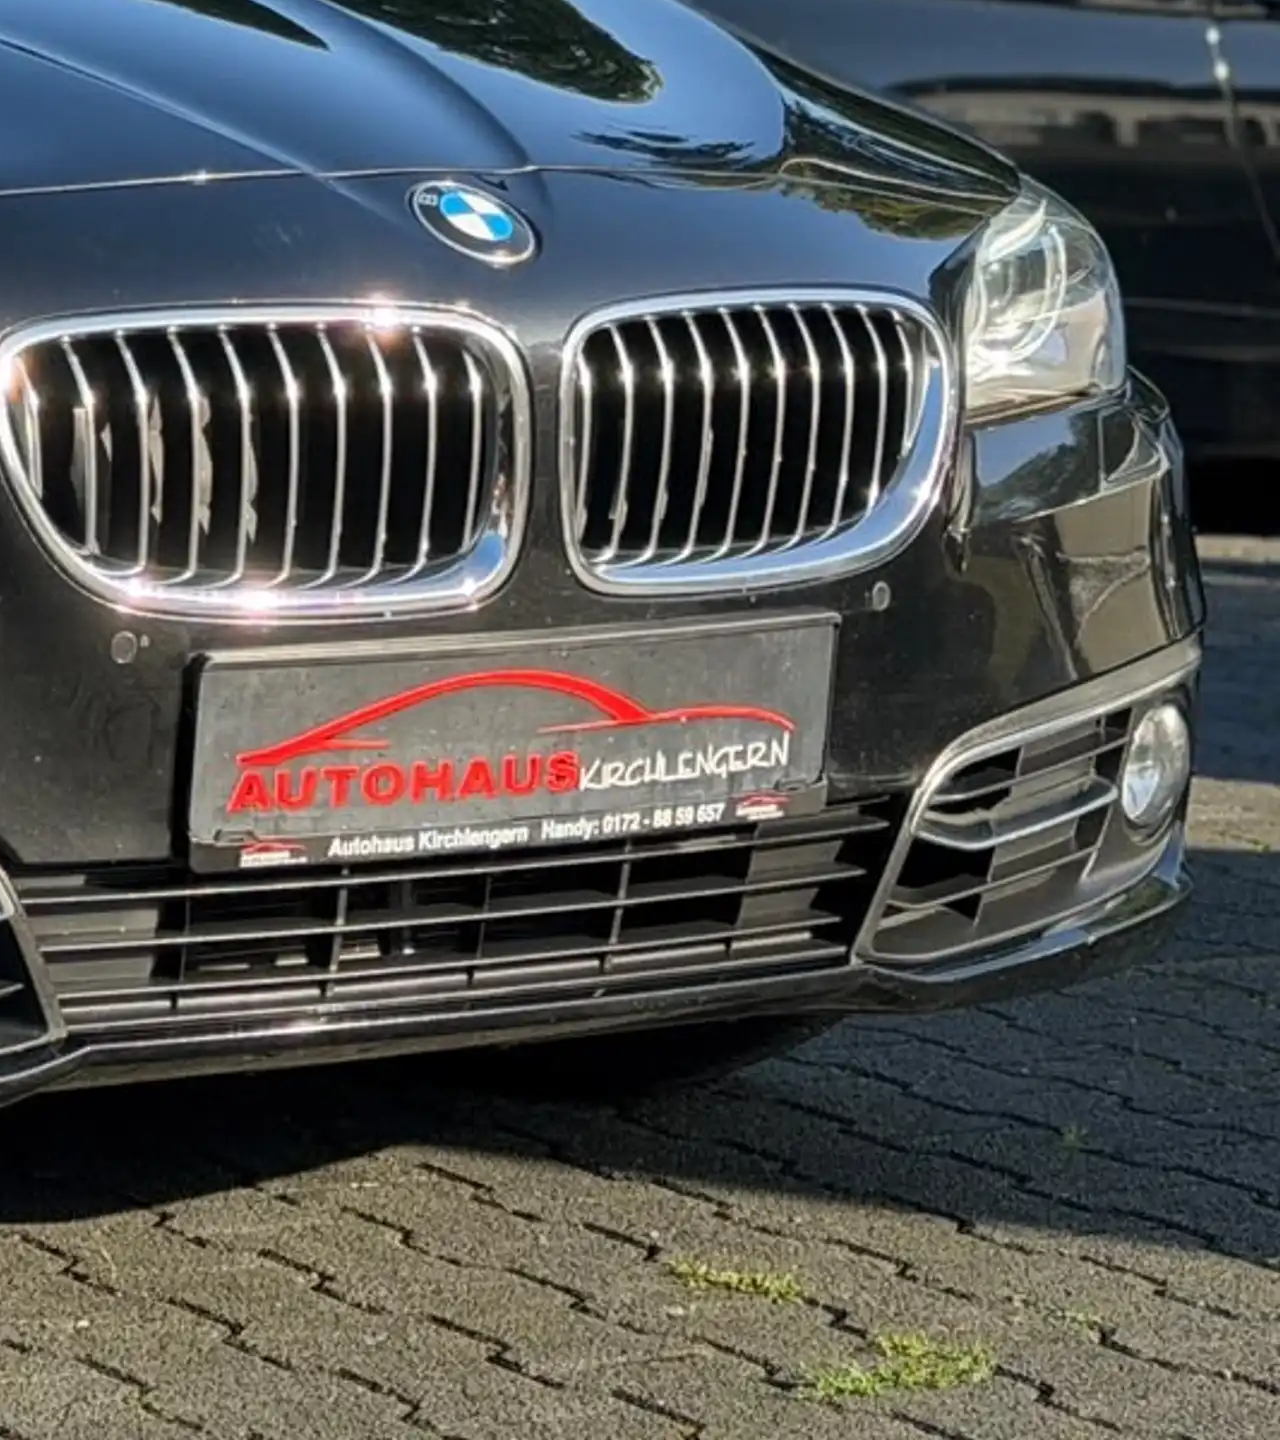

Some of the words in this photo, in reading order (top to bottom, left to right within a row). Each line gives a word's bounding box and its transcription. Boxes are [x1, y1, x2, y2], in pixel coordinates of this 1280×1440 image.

[227, 749, 580, 814] AUTOHAUS
[580, 730, 790, 792] KIRCHLENGERN
[328, 835, 415, 858] Autohaus
[418, 825, 529, 852] Kirchlengern
[541, 818, 599, 841] Handy:
[602, 812, 640, 834] 0172
